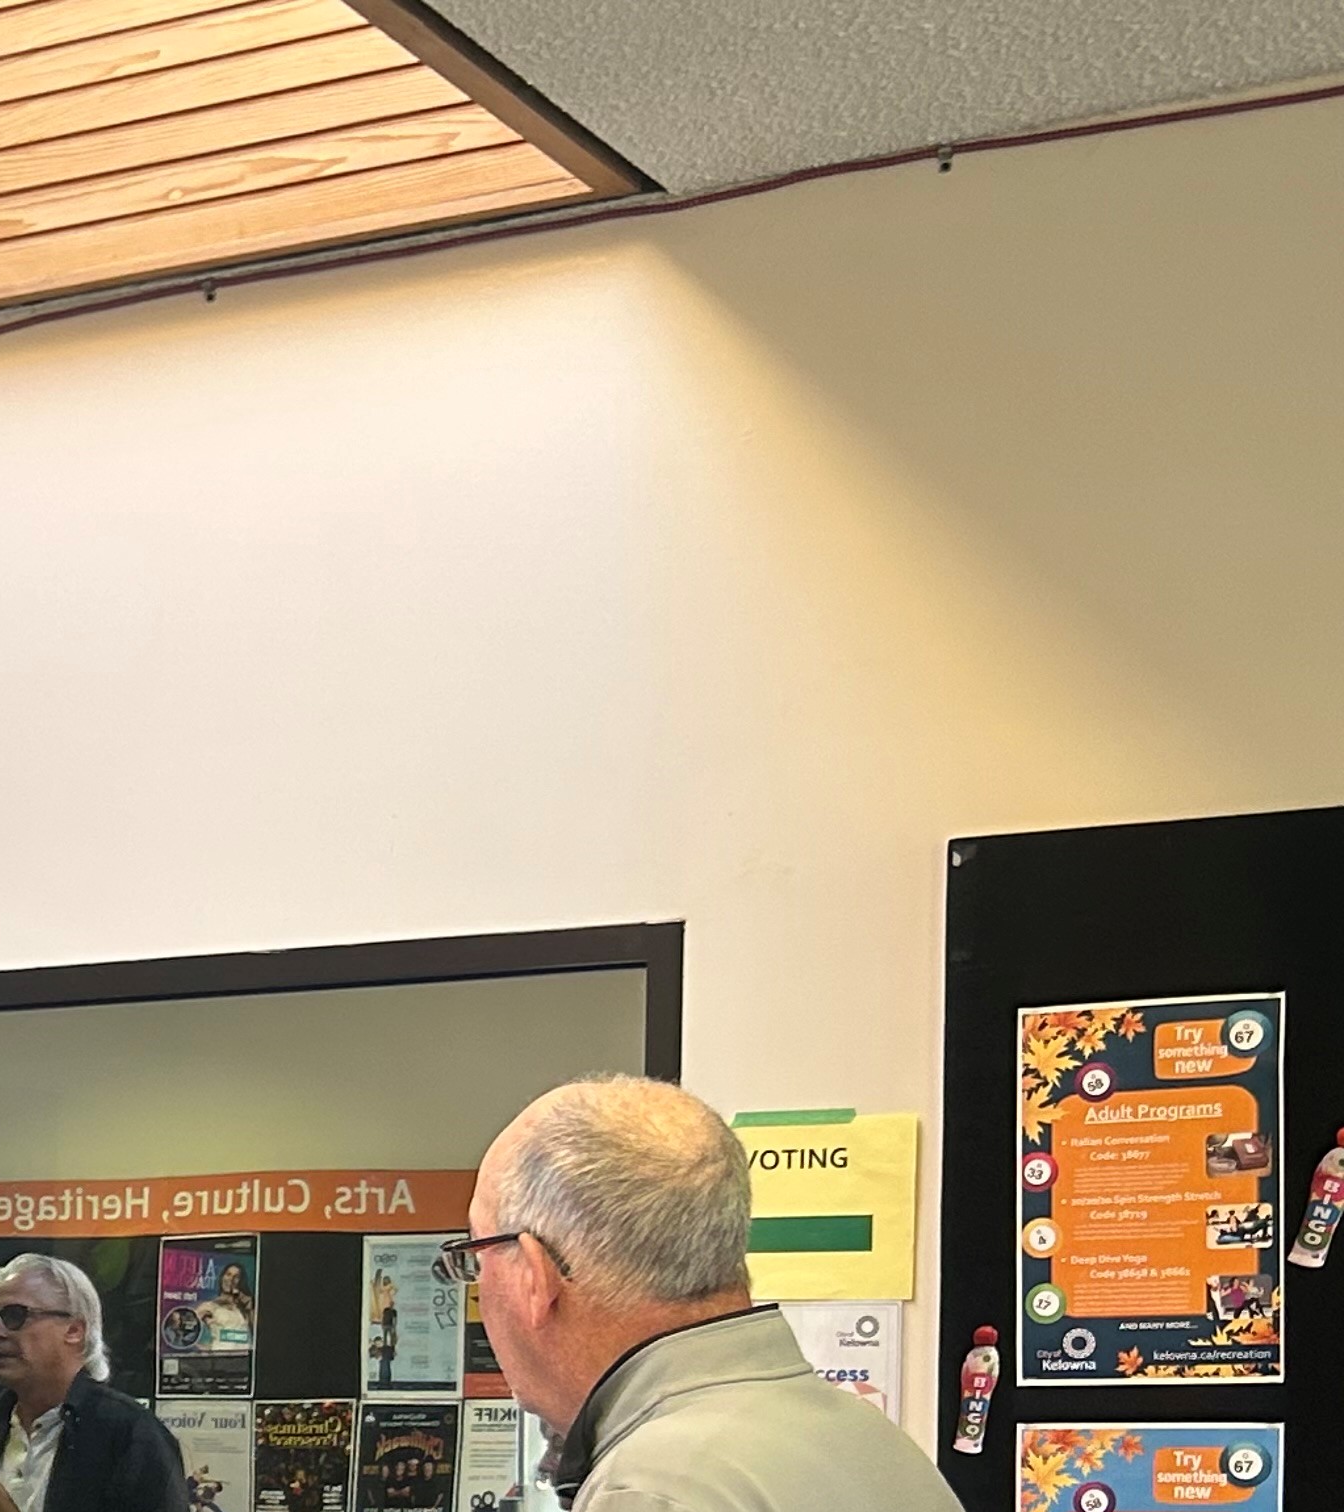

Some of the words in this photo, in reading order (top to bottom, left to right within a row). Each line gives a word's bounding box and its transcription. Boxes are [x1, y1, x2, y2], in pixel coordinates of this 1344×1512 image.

[1175, 1025, 1204, 1044] Try
[1234, 1030, 1254, 1044] 67
[1158, 1042, 1229, 1059] something
[1175, 1059, 1214, 1074] new
[1085, 1105, 1134, 1121] Adult
[1138, 1102, 1223, 1122] Programs
[1026, 1167, 1044, 1180] 33
[1303, 1179, 1341, 1246] BINGO
[1035, 1298, 1052, 1310] 17
[1153, 1348, 1272, 1362] kelowna.ca/recreation
[1042, 1359, 1097, 1372] Kelowna
[1173, 1450, 1202, 1470] Try
[1234, 1460, 1254, 1473] 67
[1157, 1469, 1228, 1486] something
[1173, 1485, 1212, 1500] new
